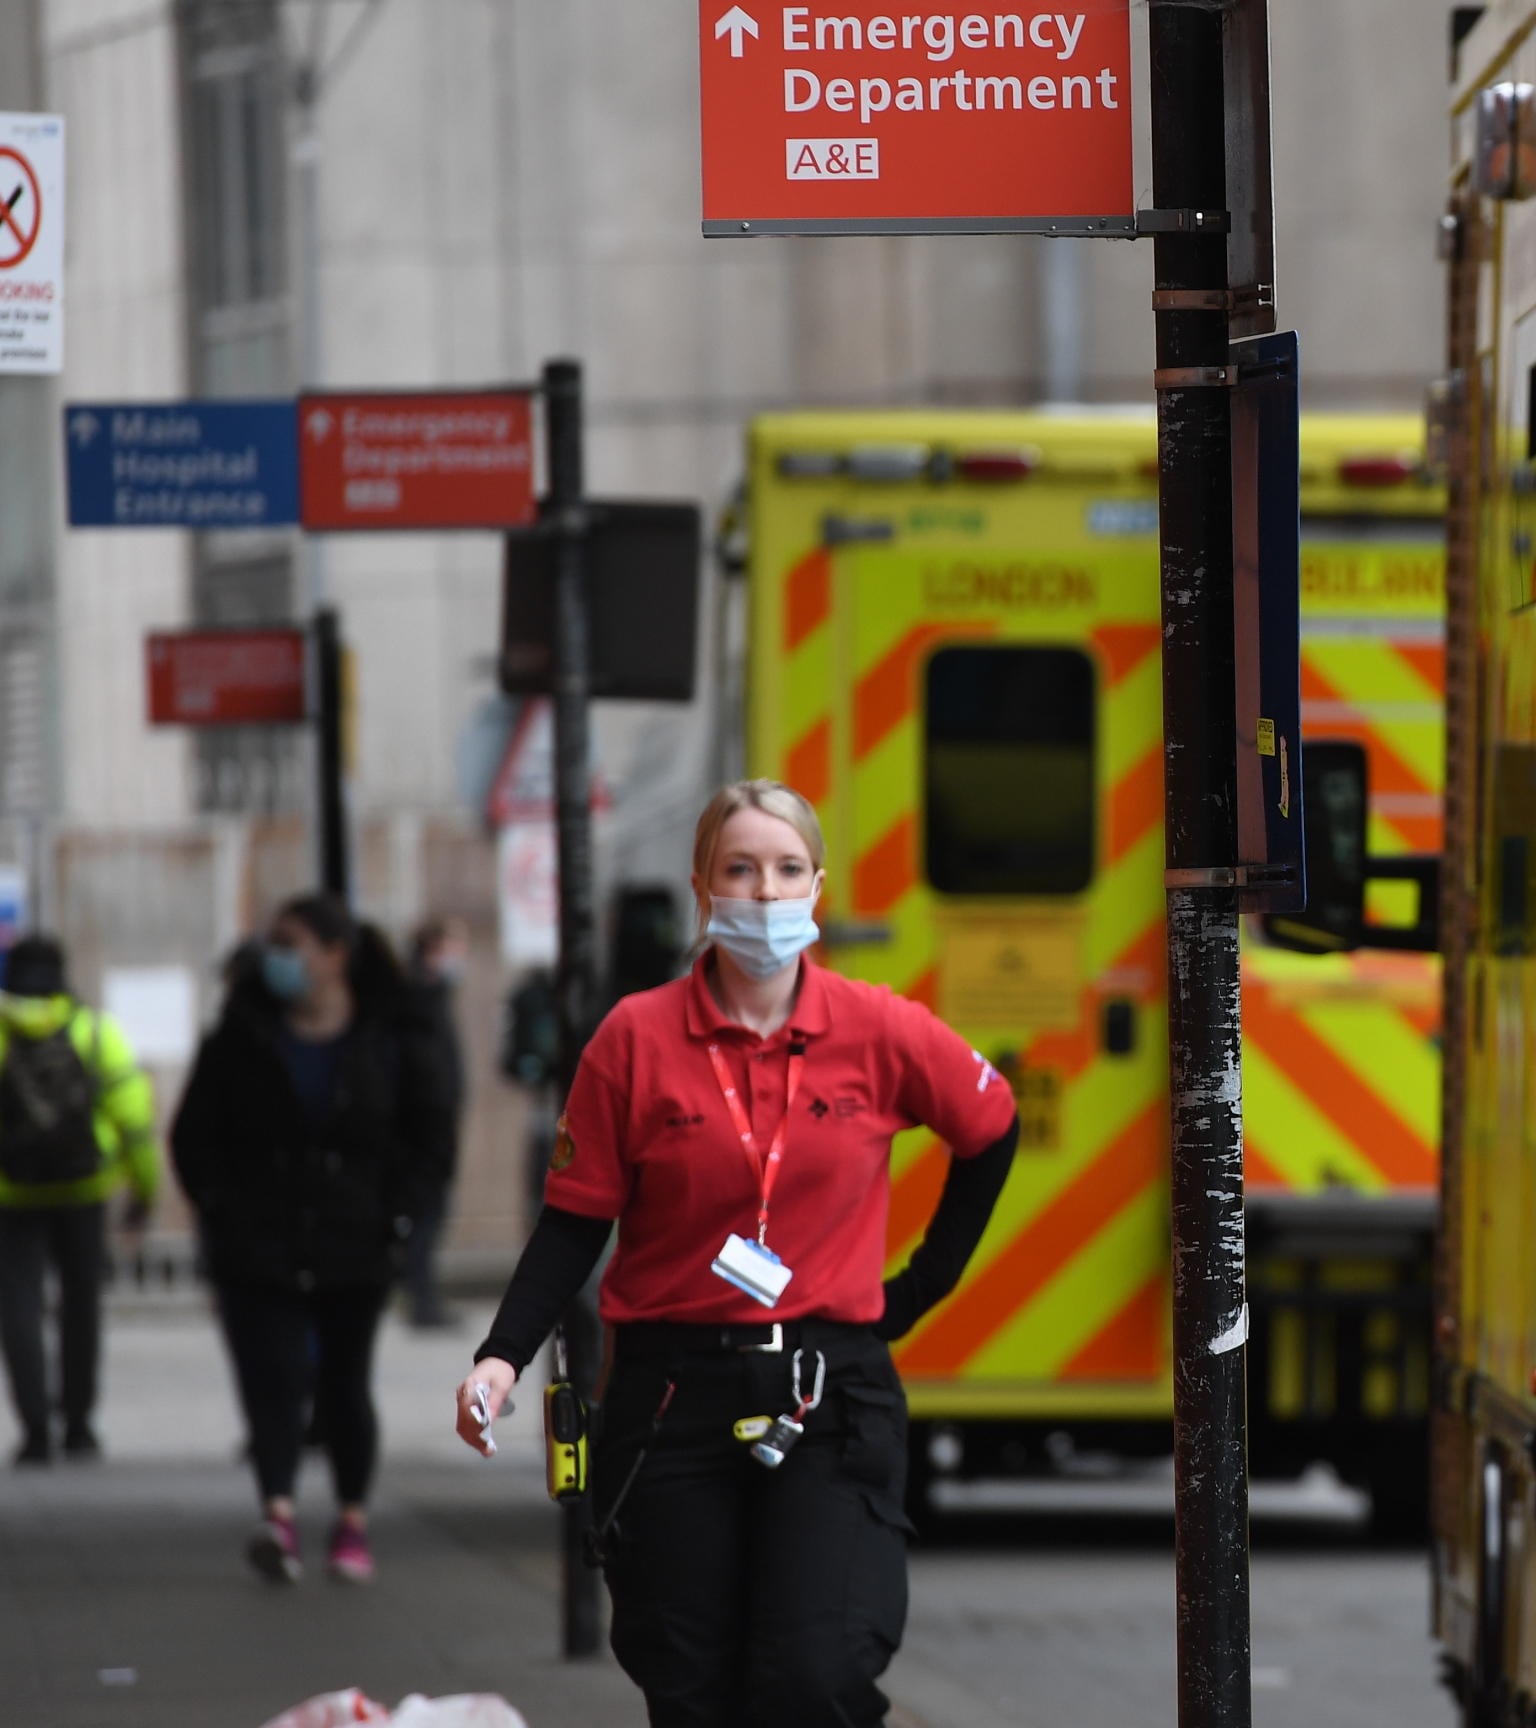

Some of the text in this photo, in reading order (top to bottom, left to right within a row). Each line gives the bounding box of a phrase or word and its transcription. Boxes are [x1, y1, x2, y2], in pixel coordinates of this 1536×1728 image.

[783, 6, 1086, 61] Emergency
[784, 67, 1119, 124] Department
[792, 143, 875, 175] A&E
[113, 412, 200, 443] Main
[342, 407, 510, 442] Emergency
[113, 447, 258, 487] Hospital
[342, 440, 528, 475] Department
[114, 486, 267, 524] Entrance
[923, 561, 1097, 605] LONDON
